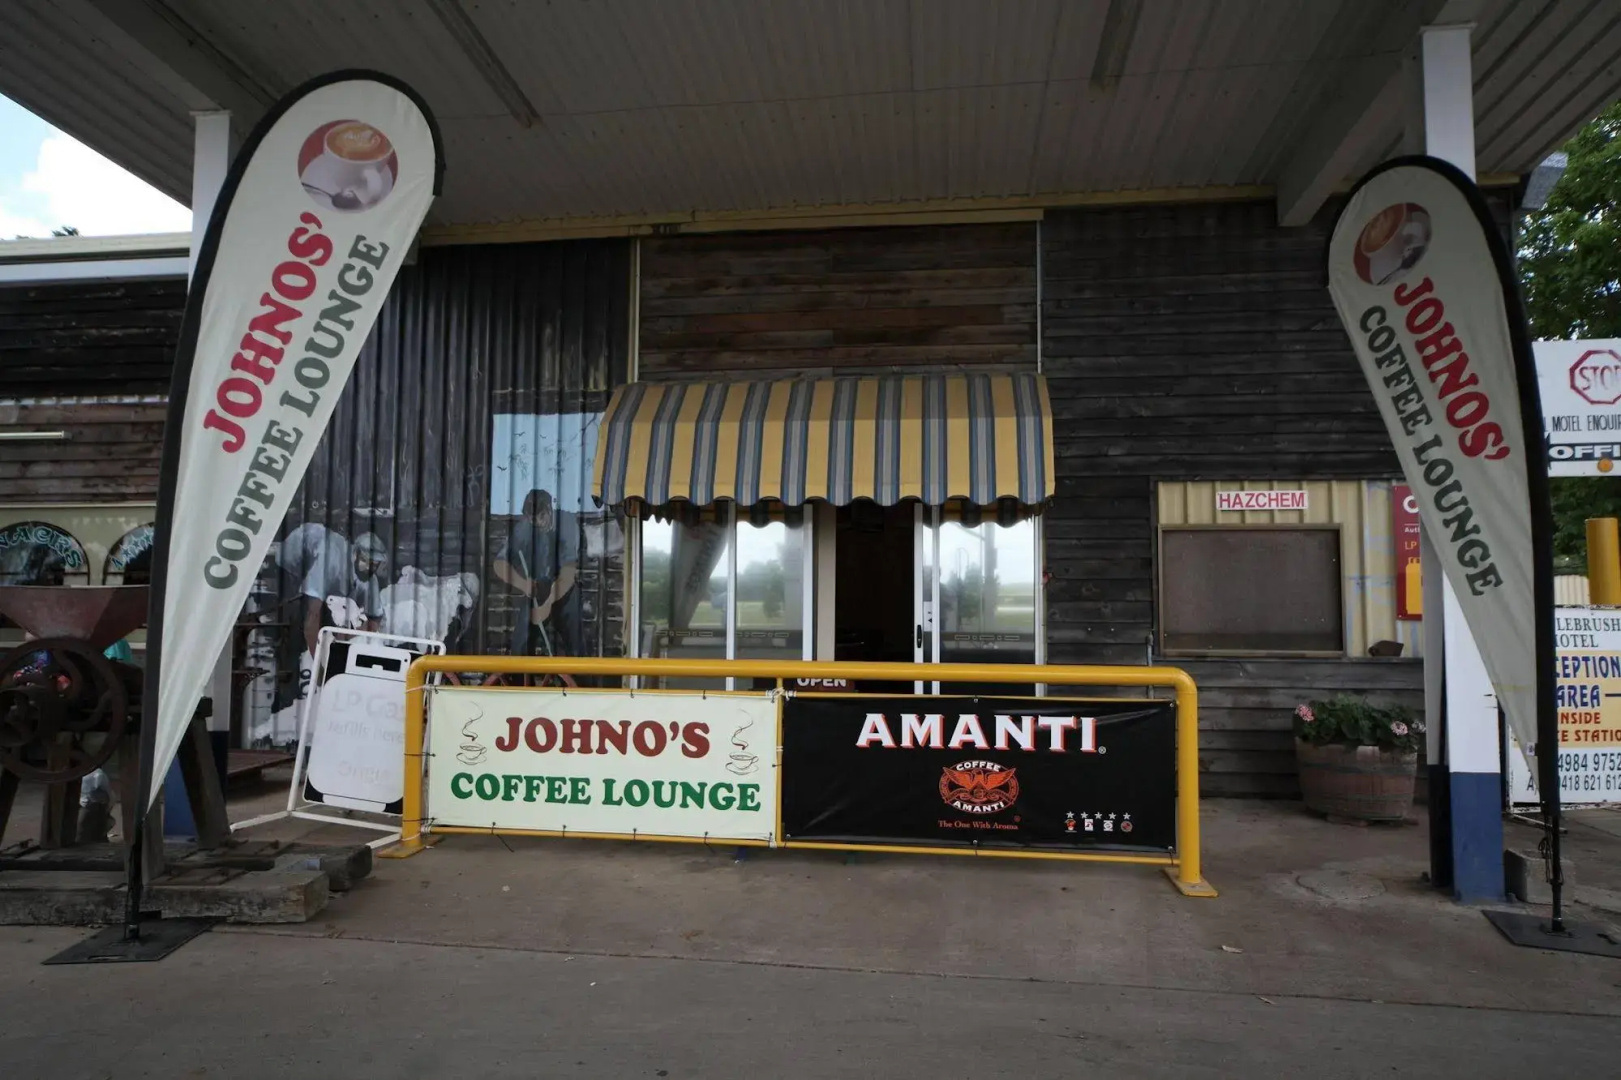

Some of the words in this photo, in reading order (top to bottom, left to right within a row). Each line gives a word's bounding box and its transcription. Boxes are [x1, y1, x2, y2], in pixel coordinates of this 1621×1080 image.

[203, 211, 333, 453] JOHNOS'
[1394, 277, 1511, 461] JOHNOS'
[204, 419, 304, 590] COFFEE
[280, 235, 390, 418] LOUNGE
[1552, 415, 1583, 432] MOTEL
[1359, 305, 1433, 436] COFFEE
[1412, 433, 1503, 596] LOUNGE
[1549, 445, 1621, 459] OFFI
[1218, 492, 1305, 508] HAZCHEM
[1557, 685, 1600, 708] AREA
[1558, 712, 1601, 724] NSIDE
[495, 716, 710, 759] JOHNO'S
[856, 713, 1097, 752] AMANTI
[956, 761, 1001, 772] COFFEE
[1558, 753, 1588, 772] 4984
[451, 772, 591, 804] COFFEE
[602, 778, 761, 811] LOUNGE
[1559, 775, 1580, 791] 418
[1584, 774, 1601, 791] 621
[953, 800, 1005, 812] AMANTI
[938, 820, 953, 828] The
[954, 820, 970, 828] One
[973, 821, 990, 829] With
[993, 822, 1018, 830] Aroma
